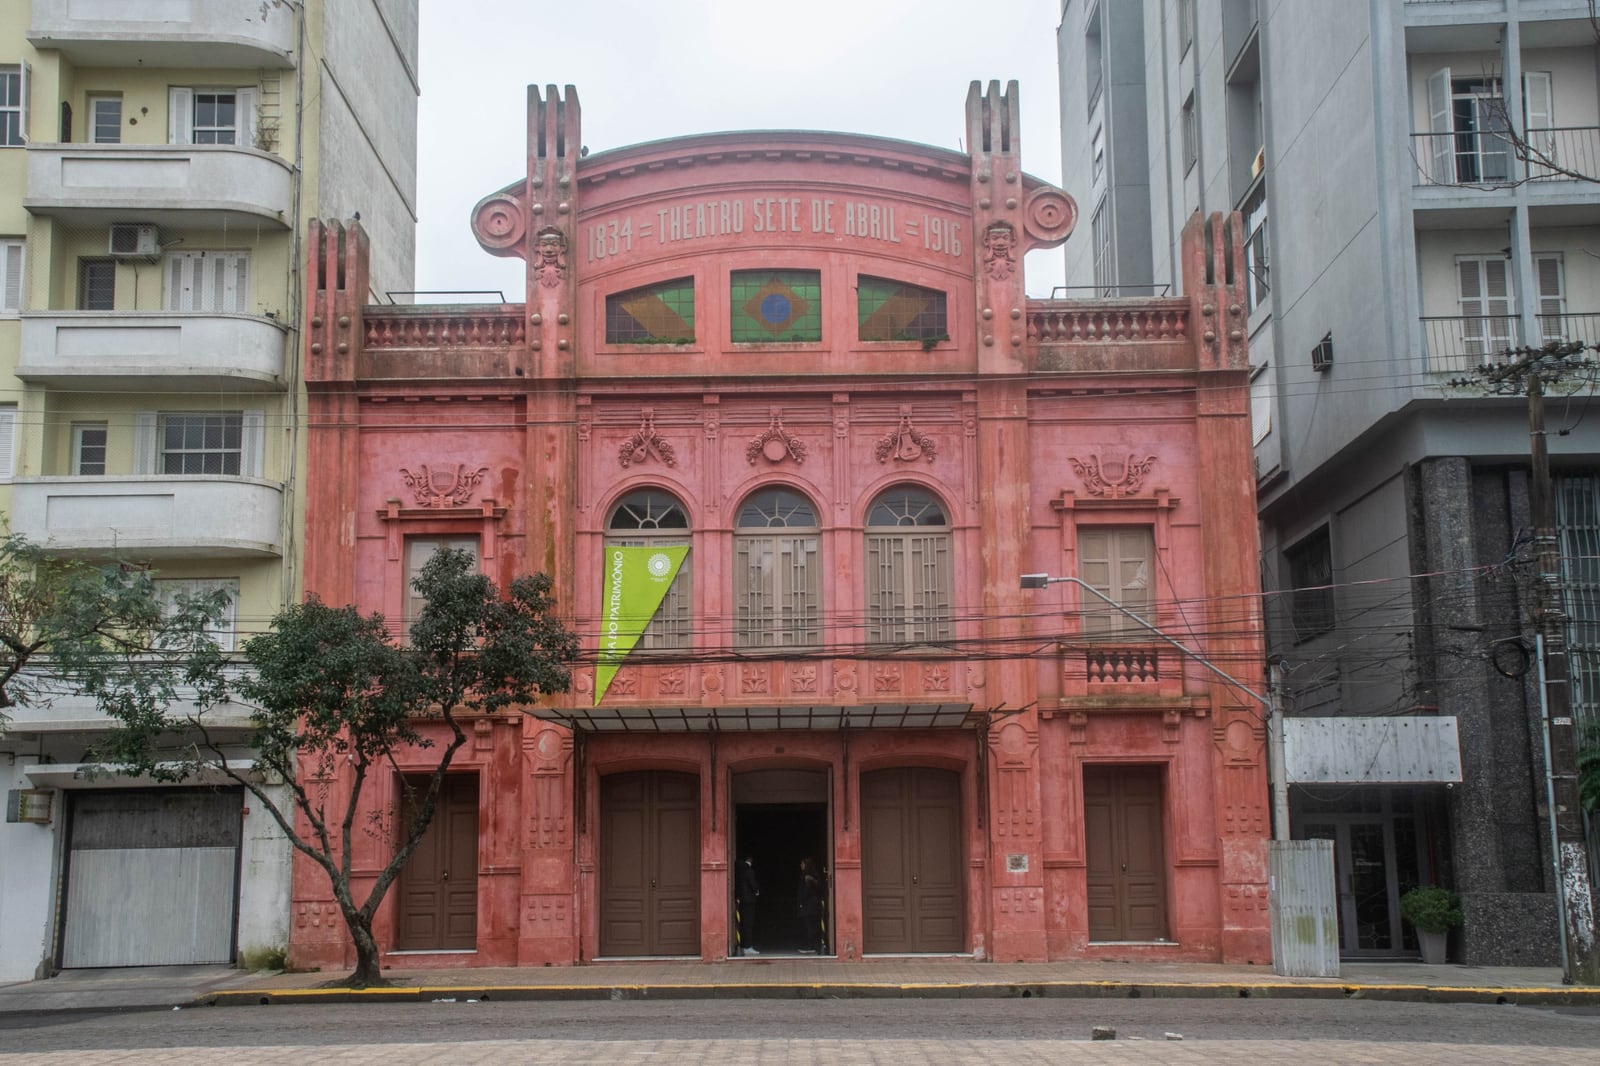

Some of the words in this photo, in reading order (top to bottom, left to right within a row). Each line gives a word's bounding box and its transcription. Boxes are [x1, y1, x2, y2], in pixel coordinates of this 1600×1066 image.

[588, 216, 632, 262] 1834
[657, 200, 744, 244] THEATRO
[754, 197, 803, 232] SETE
[811, 198, 835, 234] DE
[845, 201, 901, 243] ABRIL
[923, 214, 963, 257] 1916
[609, 551, 624, 620] PATRIMÔNIO
[608, 621, 618, 639] DO
